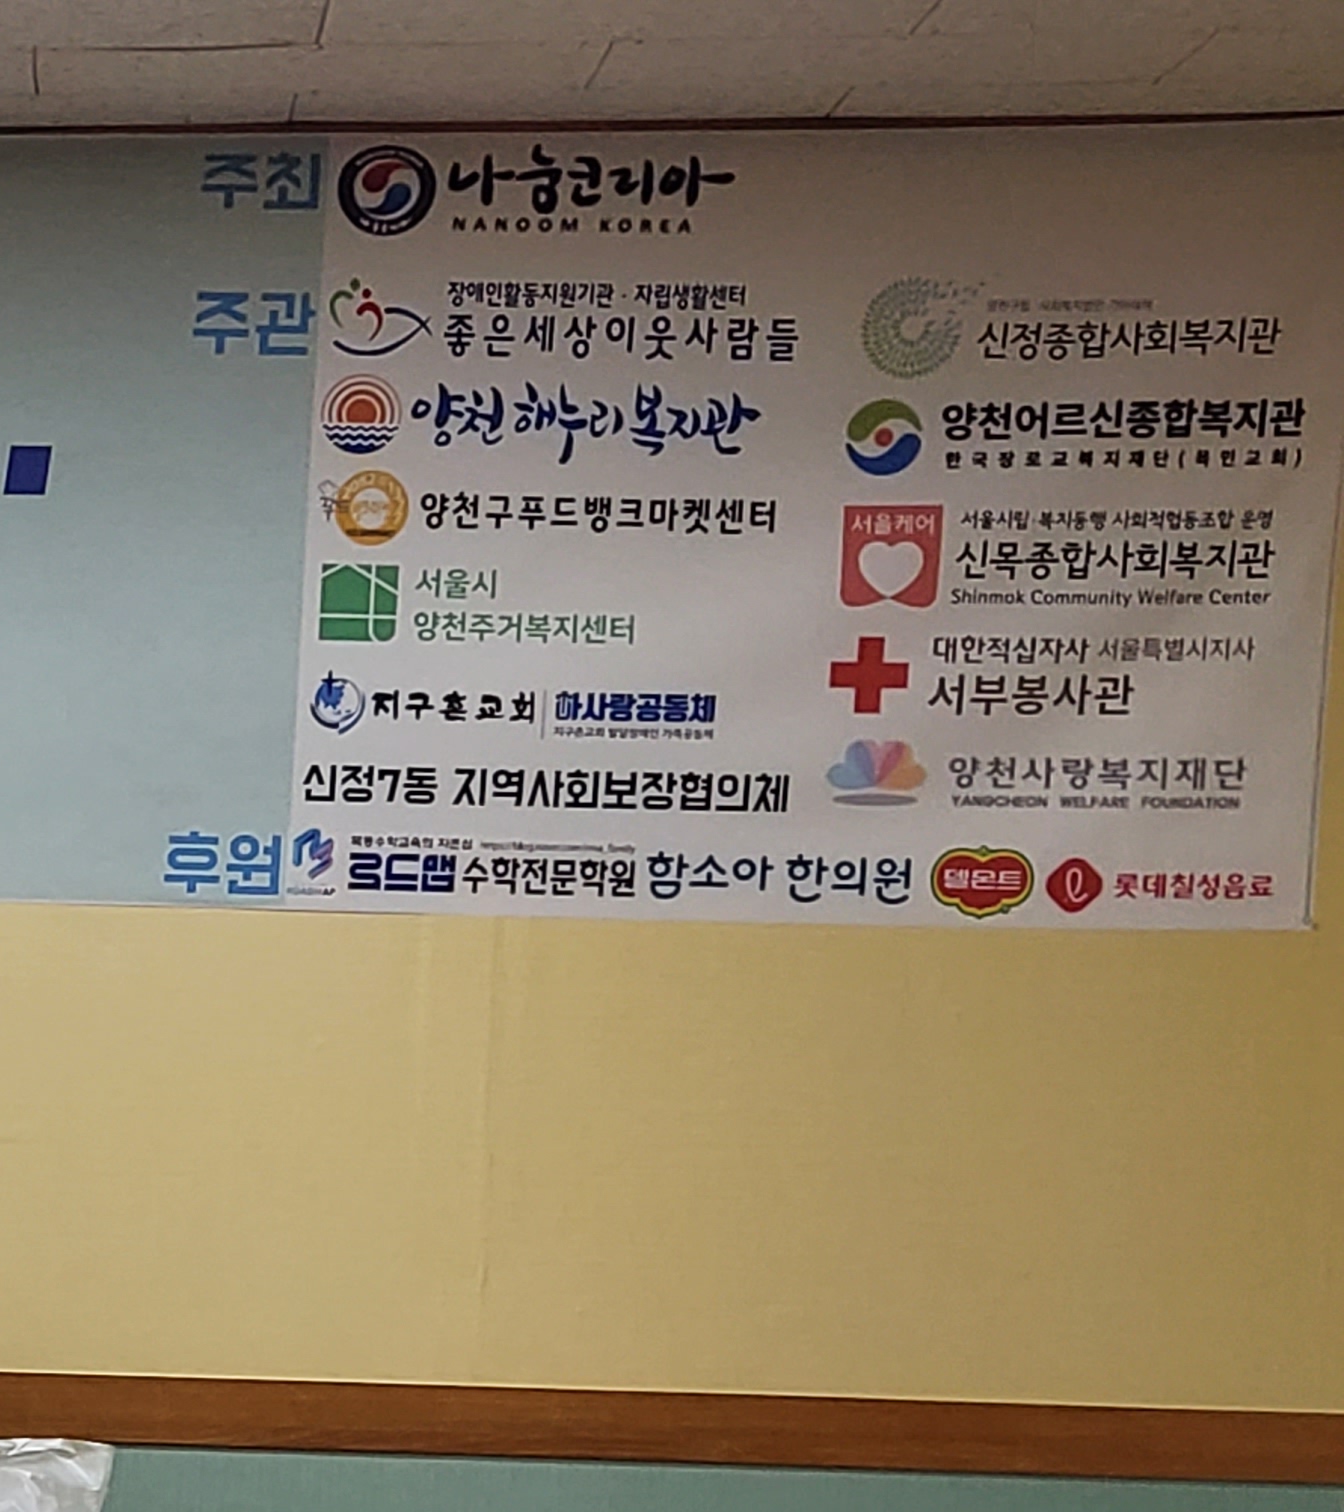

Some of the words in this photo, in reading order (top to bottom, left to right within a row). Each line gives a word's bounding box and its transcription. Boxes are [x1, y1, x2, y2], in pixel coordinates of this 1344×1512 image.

[201, 152, 321, 212] 주최
[448, 143, 736, 214] 나눔코리아
[452, 217, 580, 233] NANOOM
[600, 217, 692, 234] KOREA
[447, 280, 615, 306] 장애인활동지원기관
[633, 283, 747, 309] 자립생활센터
[192, 290, 316, 357] 주관
[443, 313, 800, 361] 좋은세상이웃사람들
[977, 318, 1281, 361] 신정종합사회복지관
[942, 398, 1305, 441] 양천어르신종합복지관
[420, 490, 778, 534] 양천구푸드뱅크마켓센터
[852, 514, 935, 534] 서울케어
[1240, 509, 1273, 529] 운영
[956, 541, 1275, 580] 신목종합사회복지관
[415, 568, 498, 598] 서울시
[951, 588, 1025, 606] Shinmok
[1030, 588, 1133, 608] Community
[1138, 588, 1203, 605] Welfare
[1208, 588, 1272, 606] Center
[414, 611, 636, 645] 양천주거복지센터
[933, 635, 1090, 664] 대한적십자사
[1098, 637, 1255, 662] 서울특별시지사
[372, 689, 536, 725] 지구촌교회
[928, 674, 1135, 716] 서부봉사관
[302, 764, 438, 805] 신정7동
[453, 767, 790, 814] 지역사회보장협의체
[948, 755, 1248, 791] 양천사랑복지재단
[951, 795, 1048, 808] YANGCHEON
[1060, 796, 1129, 809] WELFARE
[1140, 796, 1241, 810] FOUNDATION
[163, 830, 281, 896] 후원
[348, 852, 457, 892] 로드맵
[461, 857, 636, 897] 수학전문학원
[647, 850, 774, 901] 함소아
[786, 853, 912, 905] 한의원
[942, 868, 1021, 891] 델몬트
[1114, 872, 1275, 899] 롯데칠성음료
